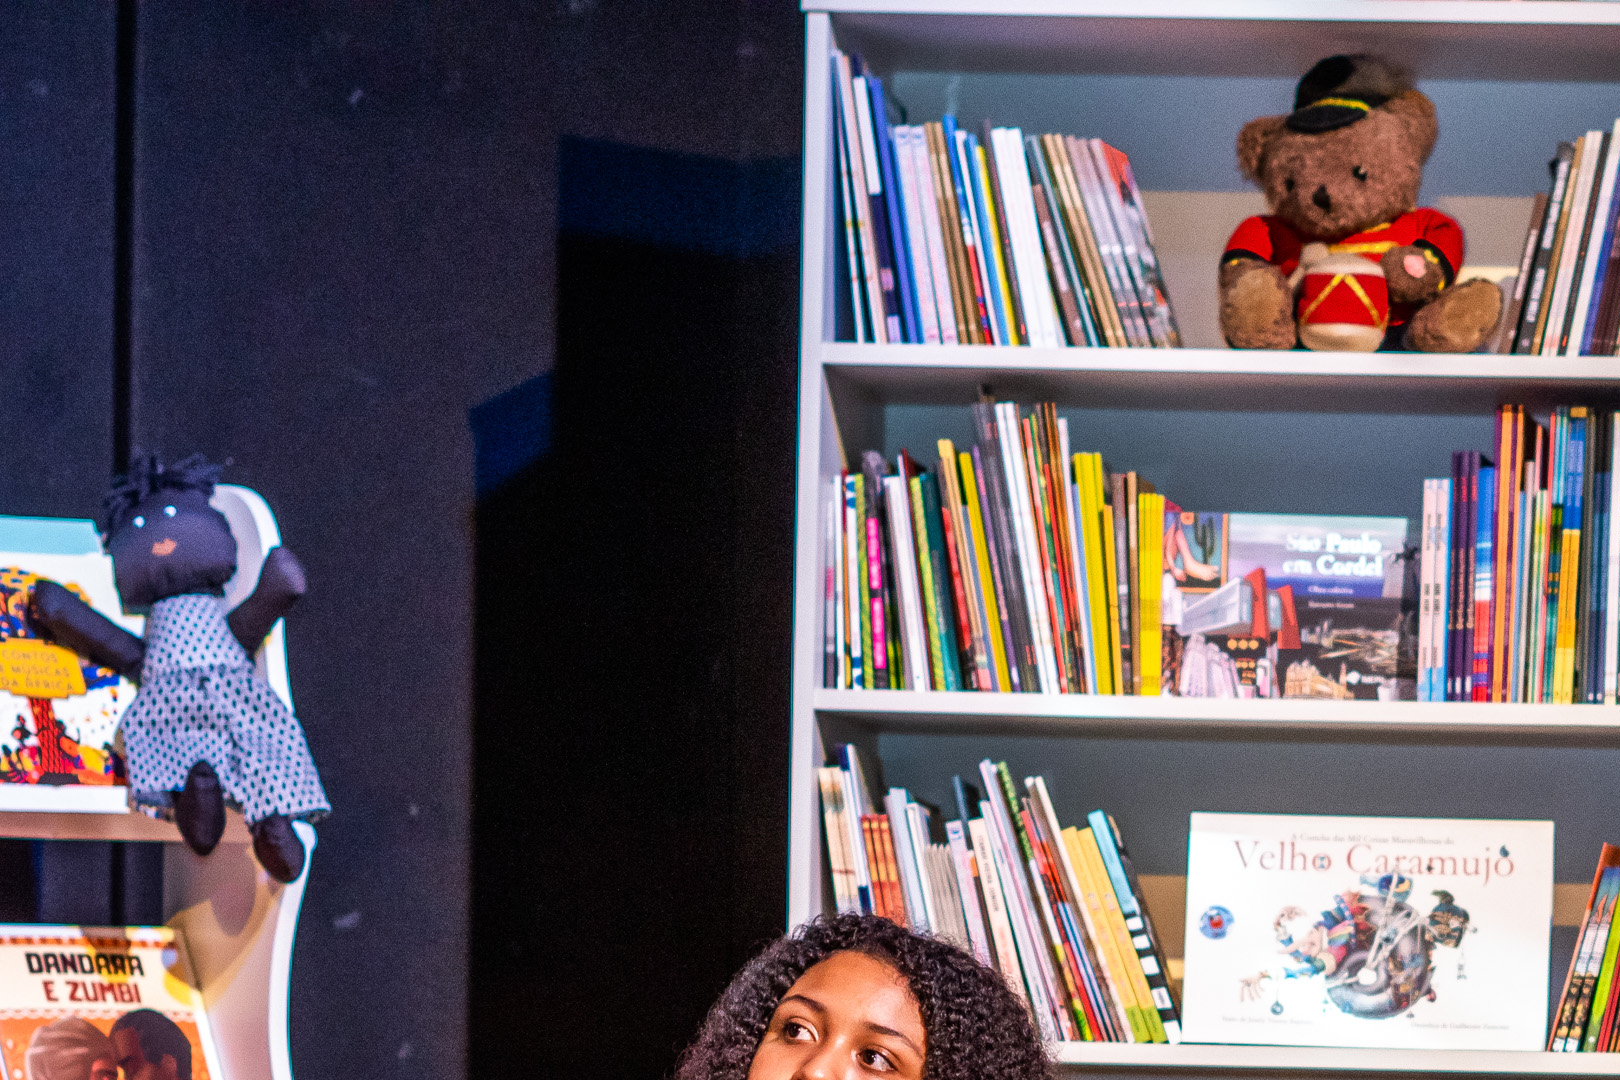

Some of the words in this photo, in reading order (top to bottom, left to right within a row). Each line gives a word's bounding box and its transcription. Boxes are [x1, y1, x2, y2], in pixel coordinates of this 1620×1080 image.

[1325, 532, 1382, 554] Paulo
[1283, 558, 1313, 574] em
[1316, 554, 1383, 577] Cordel
[1348, 834, 1361, 842] Mil
[1233, 839, 1332, 873] Velho
[1346, 843, 1516, 885] Caramujo
[25, 952, 145, 977] DANDARA
[43, 980, 59, 1002] E
[65, 980, 142, 1004] ZUMBI
